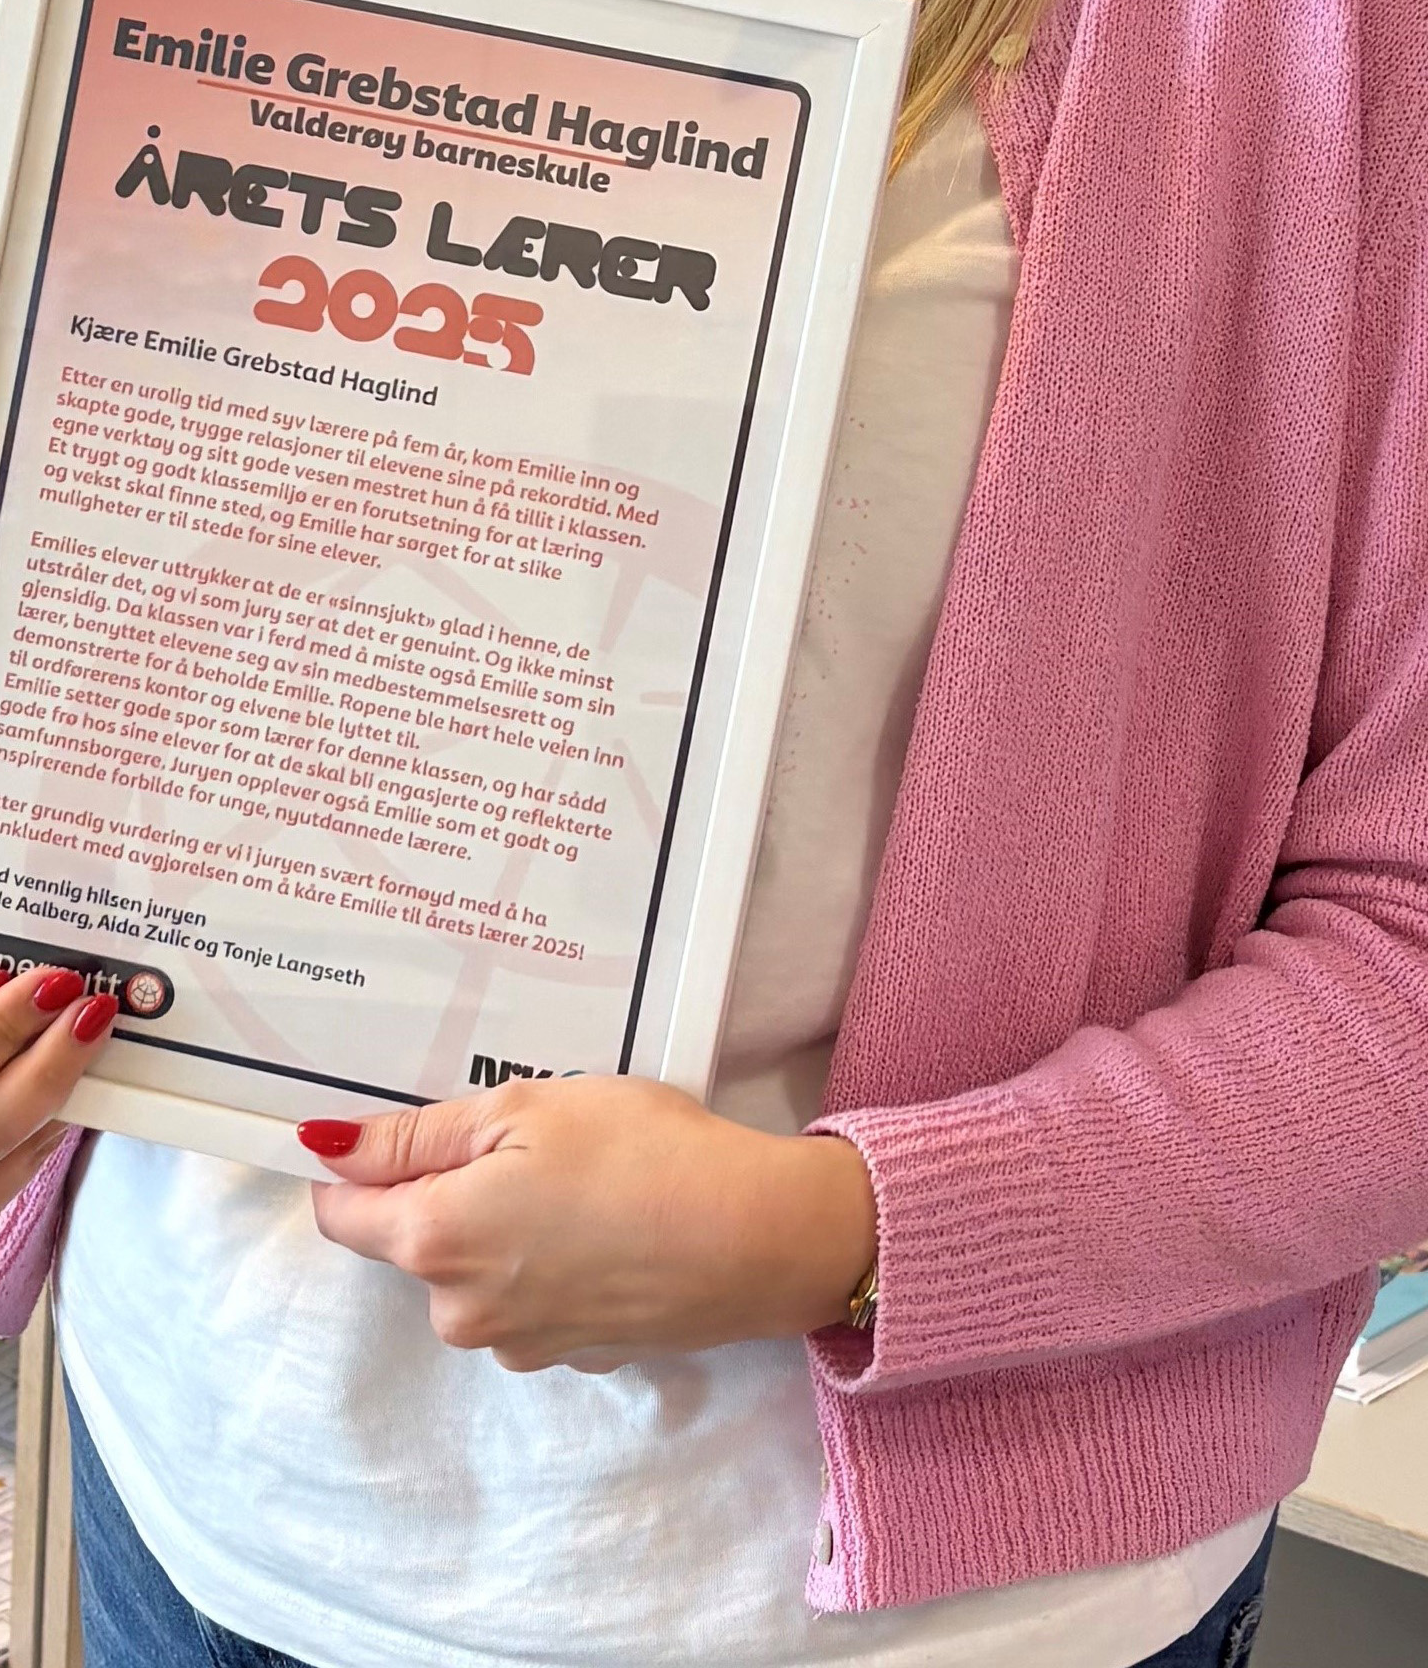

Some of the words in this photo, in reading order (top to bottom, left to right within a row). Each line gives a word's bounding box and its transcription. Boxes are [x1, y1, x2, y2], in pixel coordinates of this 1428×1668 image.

[113, 17, 275, 85] Emilie
[285, 50, 538, 137] Grebstad
[545, 96, 770, 181] Haglind
[249, 99, 406, 161] Valderøy
[412, 129, 612, 194] barneskule
[113, 124, 403, 248] ÅRETS
[425, 200, 718, 312] LÆRER
[70, 314, 139, 347] Kjære
[143, 329, 217, 362] Emilie
[222, 346, 336, 386] Grebstad
[339, 368, 439, 407] Haglind
[252, 253, 546, 377] 2025
[52, 416, 100, 437] egne
[102, 426, 175, 456] verktøy
[178, 442, 204, 462] og
[206, 445, 238, 465] sitt
[241, 455, 290, 476] gode
[294, 465, 349, 487] vesen
[352, 477, 428, 504] mestret
[430, 488, 468, 512] hun
[490, 501, 510, 521] få
[515, 507, 555, 530] tillit
[567, 517, 646, 549] klassen.
[56, 390, 120, 417] skapte
[123, 406, 175, 431] gode,
[180, 415, 244, 443] trygge
[246, 430, 343, 461] relasjoner
[346, 448, 366, 466] til
[369, 453, 444, 482] elevene
[446, 469, 486, 491] sine
[488, 478, 515, 497] på
[519, 486, 611, 517] rekordtid.
[615, 503, 660, 526] Med
[61, 365, 108, 389] Etter
[110, 379, 134, 396] en
[137, 384, 193, 410] urolig
[197, 393, 224, 413] tid
[226, 403, 269, 422] med
[271, 411, 306, 431] syv
[309, 414, 369, 443] lærere
[371, 429, 398, 449] på
[402, 434, 439, 458] fem
[443, 441, 468, 465] år,
[471, 447, 513, 472] kom
[516, 457, 576, 485] Emilie
[579, 469, 610, 492] inn
[614, 481, 640, 501] og
[38, 487, 143, 519] muligheter
[145, 508, 166, 524] er
[168, 510, 188, 529] til
[190, 517, 244, 540] stede
[247, 525, 276, 546] for
[277, 533, 317, 555] sine
[320, 542, 381, 569] elever.
[9, 648, 28, 668] til
[31, 656, 141, 690] ordførerens
[144, 675, 208, 704] kontor
[210, 693, 235, 714] og
[238, 697, 301, 724] elvene
[304, 709, 335, 731] ble
[337, 716, 392, 743] lyttet
[396, 730, 420, 750] til.
[111, 766, 184, 798] forbilde
[188, 783, 216, 805] for
[218, 794, 270, 820] unge,
[274, 806, 404, 845] nyutdannede
[406, 830, 472, 861] lærere.
[13, 873, 83, 904] vennlig
[85, 885, 142, 914] hilsen
[142, 897, 207, 928] juryen
[14, 895, 94, 930] Aalberg,
[96, 913, 141, 938] Aida
[143, 923, 191, 949] Zulic
[193, 938, 219, 958] og
[222, 940, 273, 968] Tonje
[275, 952, 365, 988] Langseth
[82, 839, 125, 860] med
[127, 849, 238, 885] avgjørelsen
[241, 874, 273, 892] om
[293, 880, 336, 906] kåre
[339, 891, 398, 919] Emilie
[401, 905, 422, 925] til
[425, 909, 475, 936] årets
[478, 921, 529, 948] lærer
[531, 934, 585, 961] 2025!
